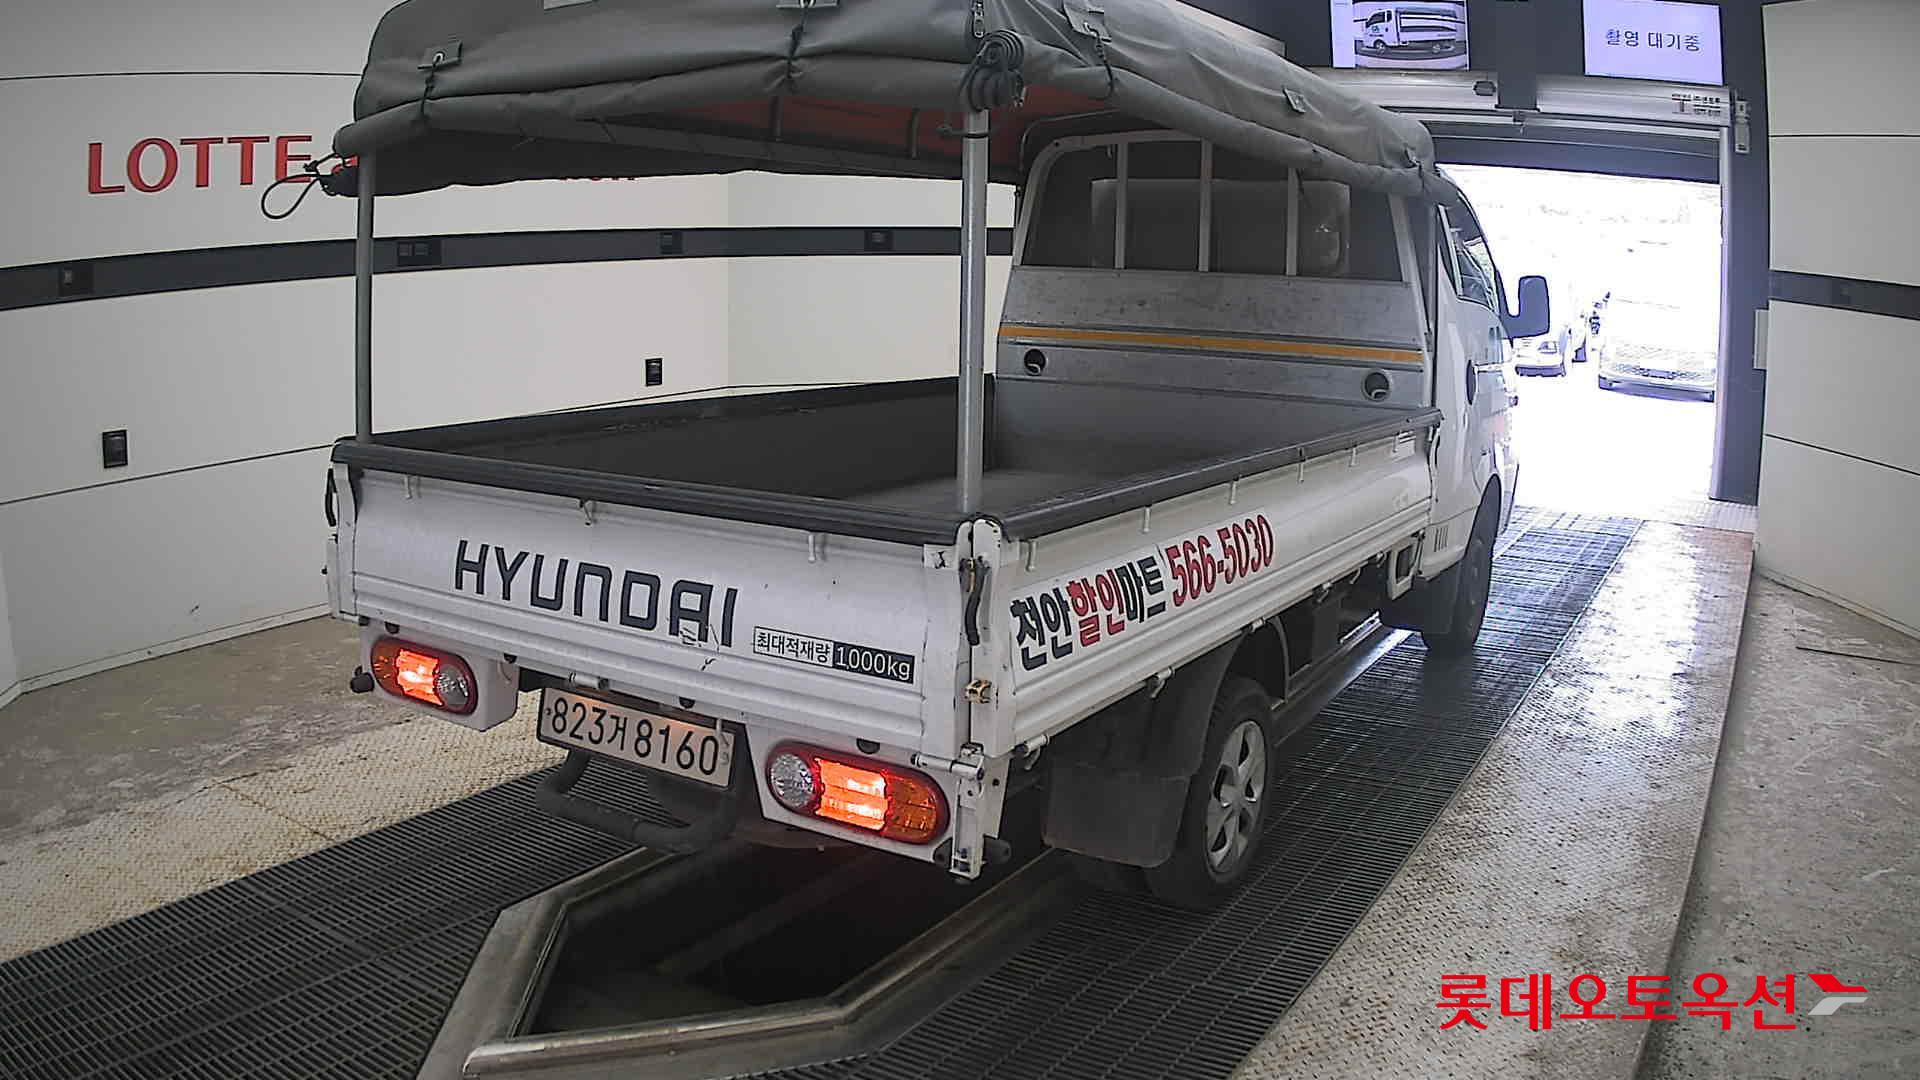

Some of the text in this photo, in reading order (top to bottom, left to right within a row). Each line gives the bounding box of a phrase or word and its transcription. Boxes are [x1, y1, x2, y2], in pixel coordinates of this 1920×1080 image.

[1647, 31, 1701, 52] 대기중
[88, 135, 312, 194] LOTTE
[454, 539, 738, 648] HYUNDAI
[1009, 514, 1275, 671] 천안할인마트 566-5030
[756, 632, 831, 664] 최대적재량
